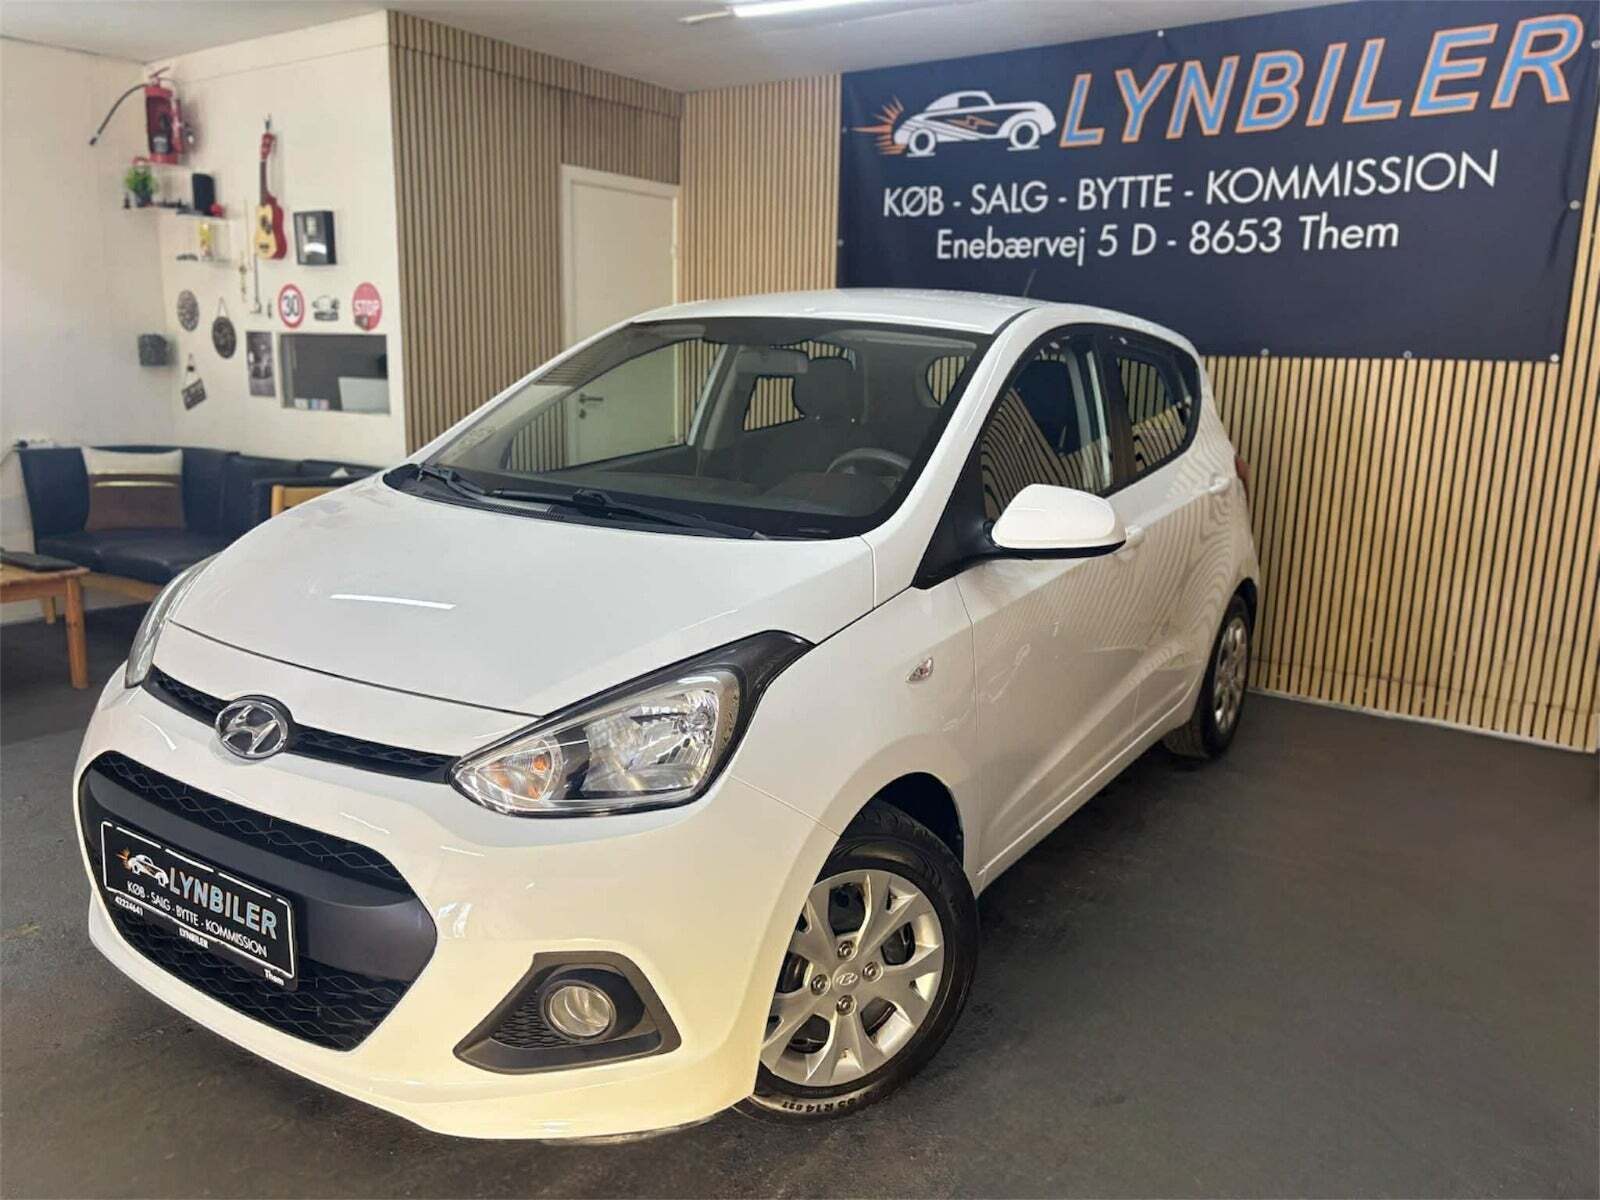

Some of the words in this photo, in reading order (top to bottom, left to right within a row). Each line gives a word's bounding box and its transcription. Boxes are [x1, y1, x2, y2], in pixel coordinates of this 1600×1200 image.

[1059, 13, 1584, 149] LYNBILER
[884, 186, 945, 218] KØB
[970, 180, 1050, 215] SALG
[1078, 173, 1174, 211] BYTTE
[1206, 148, 1499, 205] KOMMISSION
[936, 226, 1087, 267] Enebærvej
[1097, 224, 1119, 257] 5
[1131, 223, 1158, 256] D
[1188, 216, 1283, 255] 8653
[1298, 211, 1400, 251] Them
[283, 294, 300, 317] 30
[354, 299, 379, 316] STOP
[127, 881, 145, 898] KØB
[150, 892, 171, 912] SALG
[175, 905, 199, 927] BYTTE
[205, 919, 268, 959] KOMMISSION
[169, 867, 277, 940] LYNBILER
